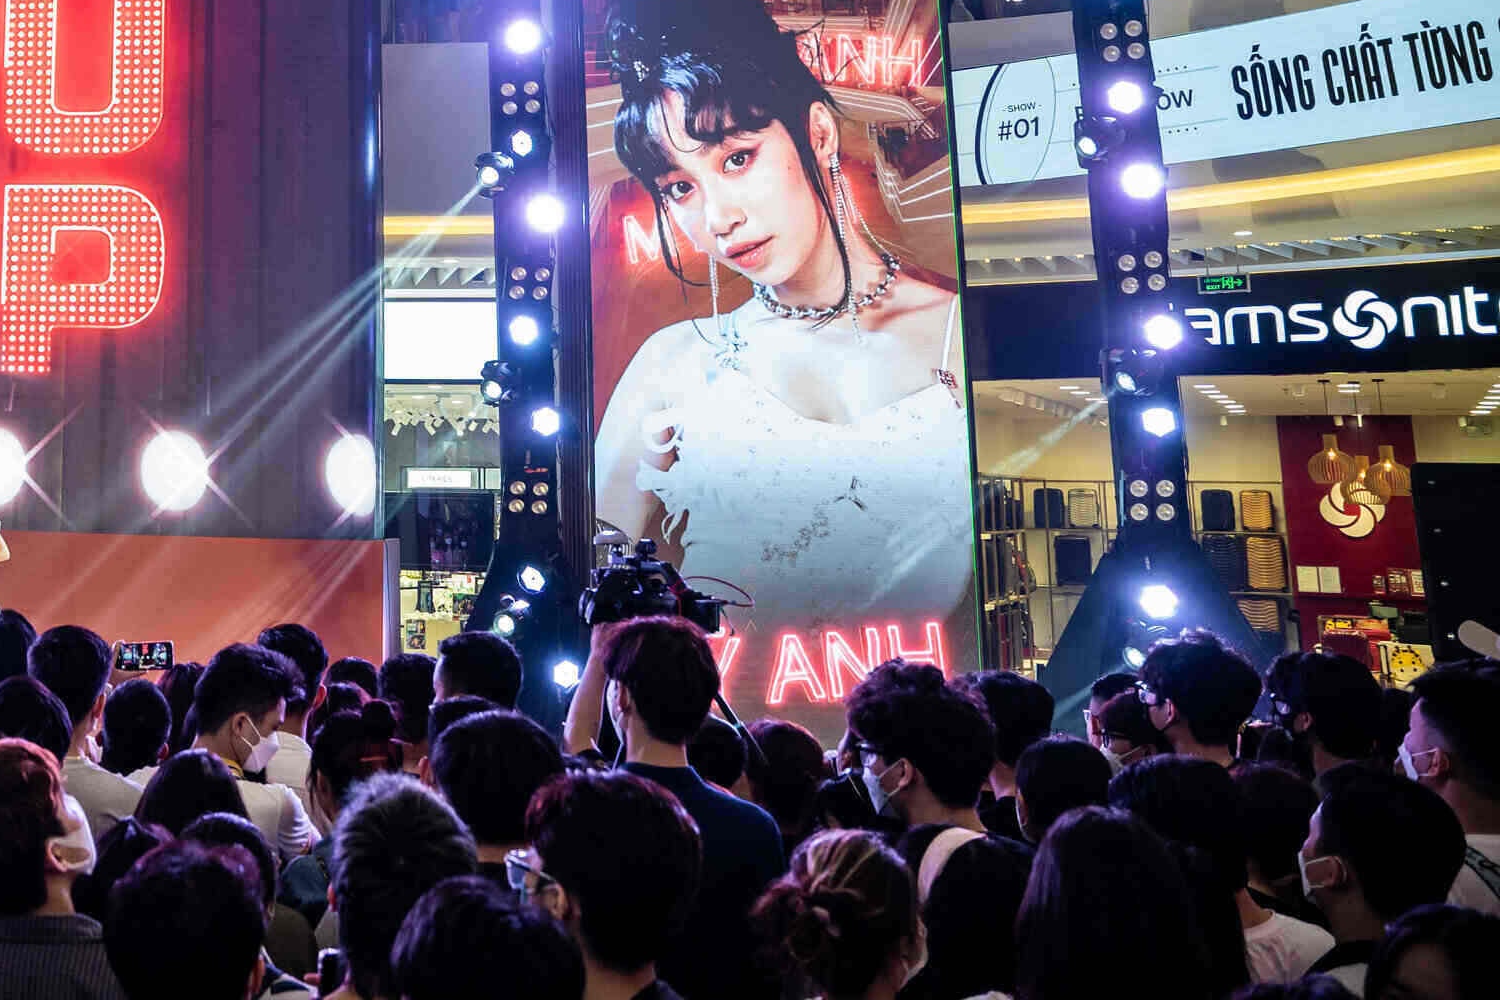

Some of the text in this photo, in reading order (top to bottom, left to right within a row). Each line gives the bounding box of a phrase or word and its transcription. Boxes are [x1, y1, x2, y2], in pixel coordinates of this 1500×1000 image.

[1231, 20, 1494, 120] SỐNG CHẤT TỪNG
[998, 116, 1041, 140] #01
[1007, 101, 1037, 113] SHOW
[766, 622, 946, 704] ANH
